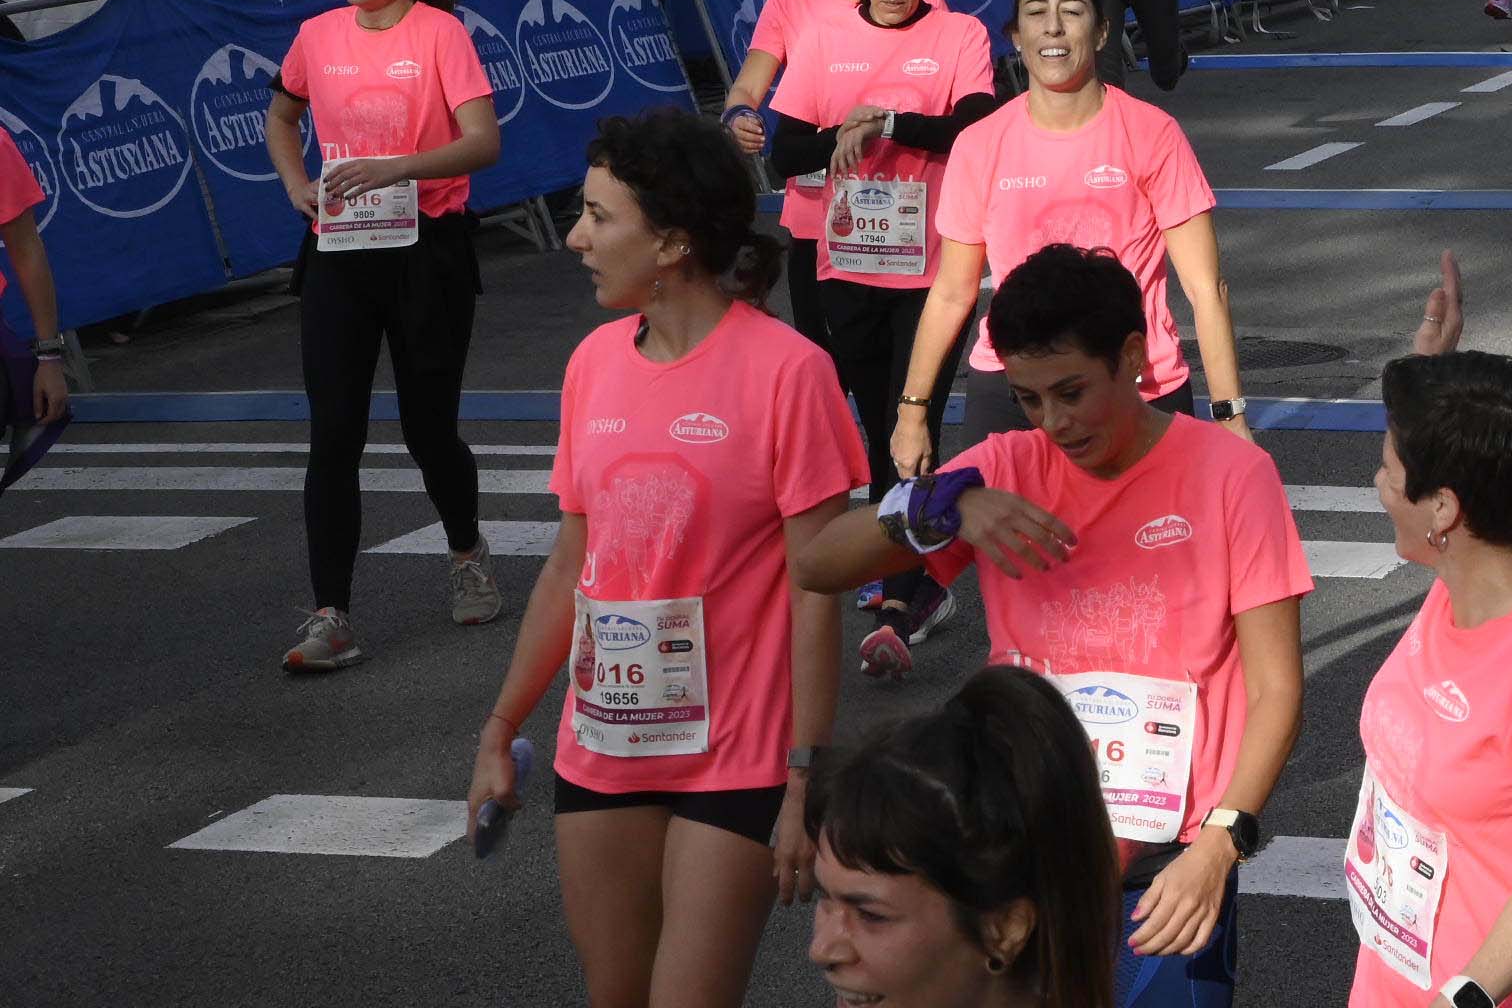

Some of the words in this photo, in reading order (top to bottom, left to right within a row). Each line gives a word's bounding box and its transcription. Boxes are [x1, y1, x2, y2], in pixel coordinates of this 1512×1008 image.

[618, 24, 677, 68] ASTUR
[525, 39, 610, 84] ASTURIANA
[829, 63, 869, 73] OYSHO
[324, 64, 360, 75] OYSHO
[202, 102, 267, 154] ASTUR
[69, 130, 185, 191] ASTURIANA
[999, 175, 1047, 191] OYSHO
[348, 194, 382, 207] 016
[353, 211, 375, 219] 9809
[856, 217, 890, 231] 016
[860, 235, 885, 243] 17940
[657, 622, 690, 631] SUMA
[599, 630, 645, 641] TURIANA
[597, 663, 645, 685] 016
[600, 692, 639, 705] 19656
[1146, 701, 1181, 712] SUMA
[616, 713, 628, 721] LA
[630, 713, 664, 721] MUJER
[668, 711, 691, 719] 2023
[642, 731, 697, 743] Santander
[1142, 794, 1167, 806] 2023
[1111, 813, 1167, 831] Santander
[1401, 930, 1418, 948] 2023
[1382, 939, 1420, 974] Santander
